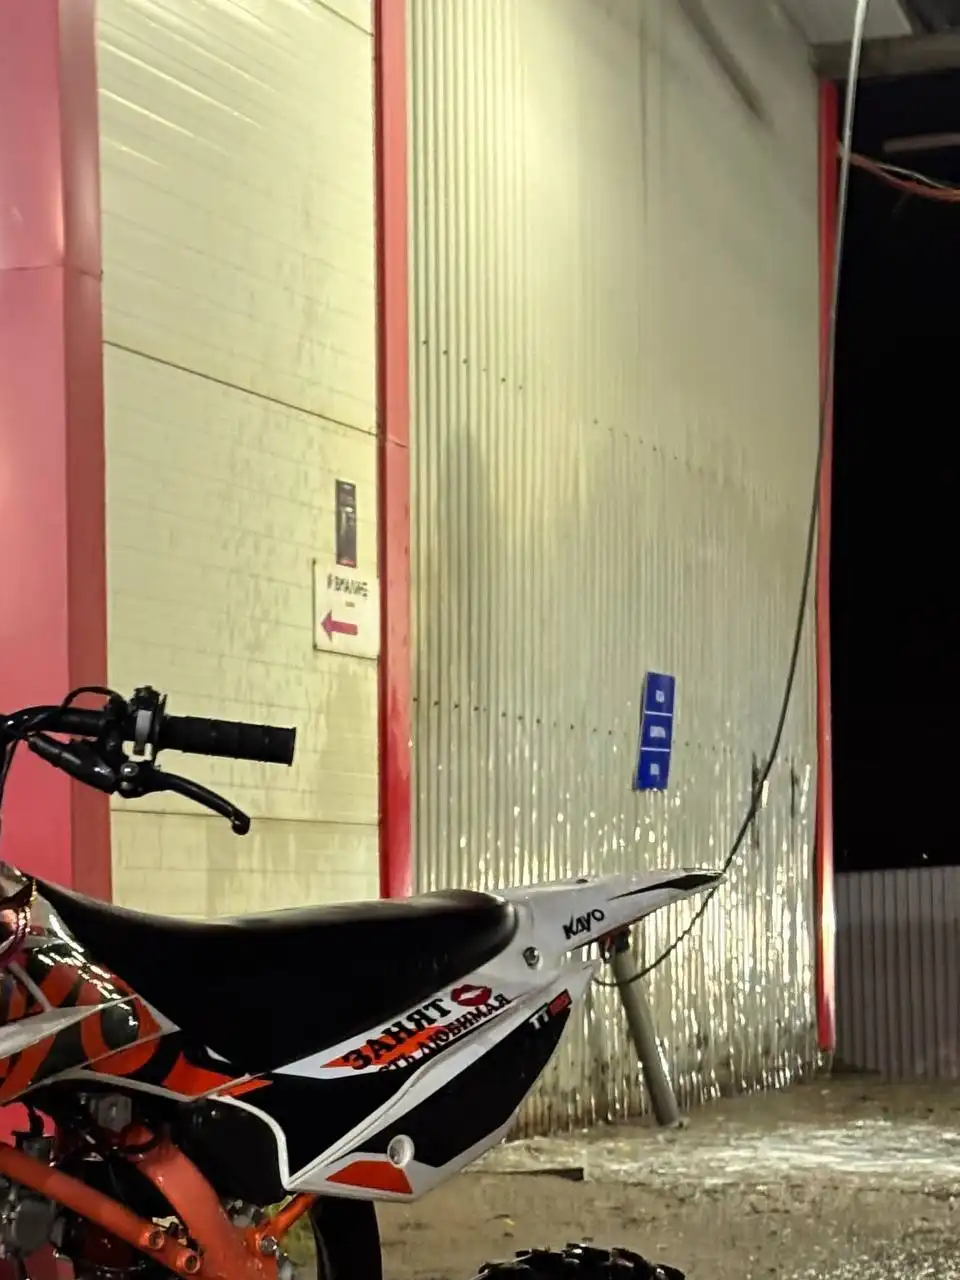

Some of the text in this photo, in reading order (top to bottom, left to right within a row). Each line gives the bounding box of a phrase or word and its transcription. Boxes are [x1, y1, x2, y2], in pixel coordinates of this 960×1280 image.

[562, 909, 605, 940] KAYO
[341, 998, 452, 1071] ЗАНЯТ
[419, 993, 512, 1058] ЛЮБИМАЯ
